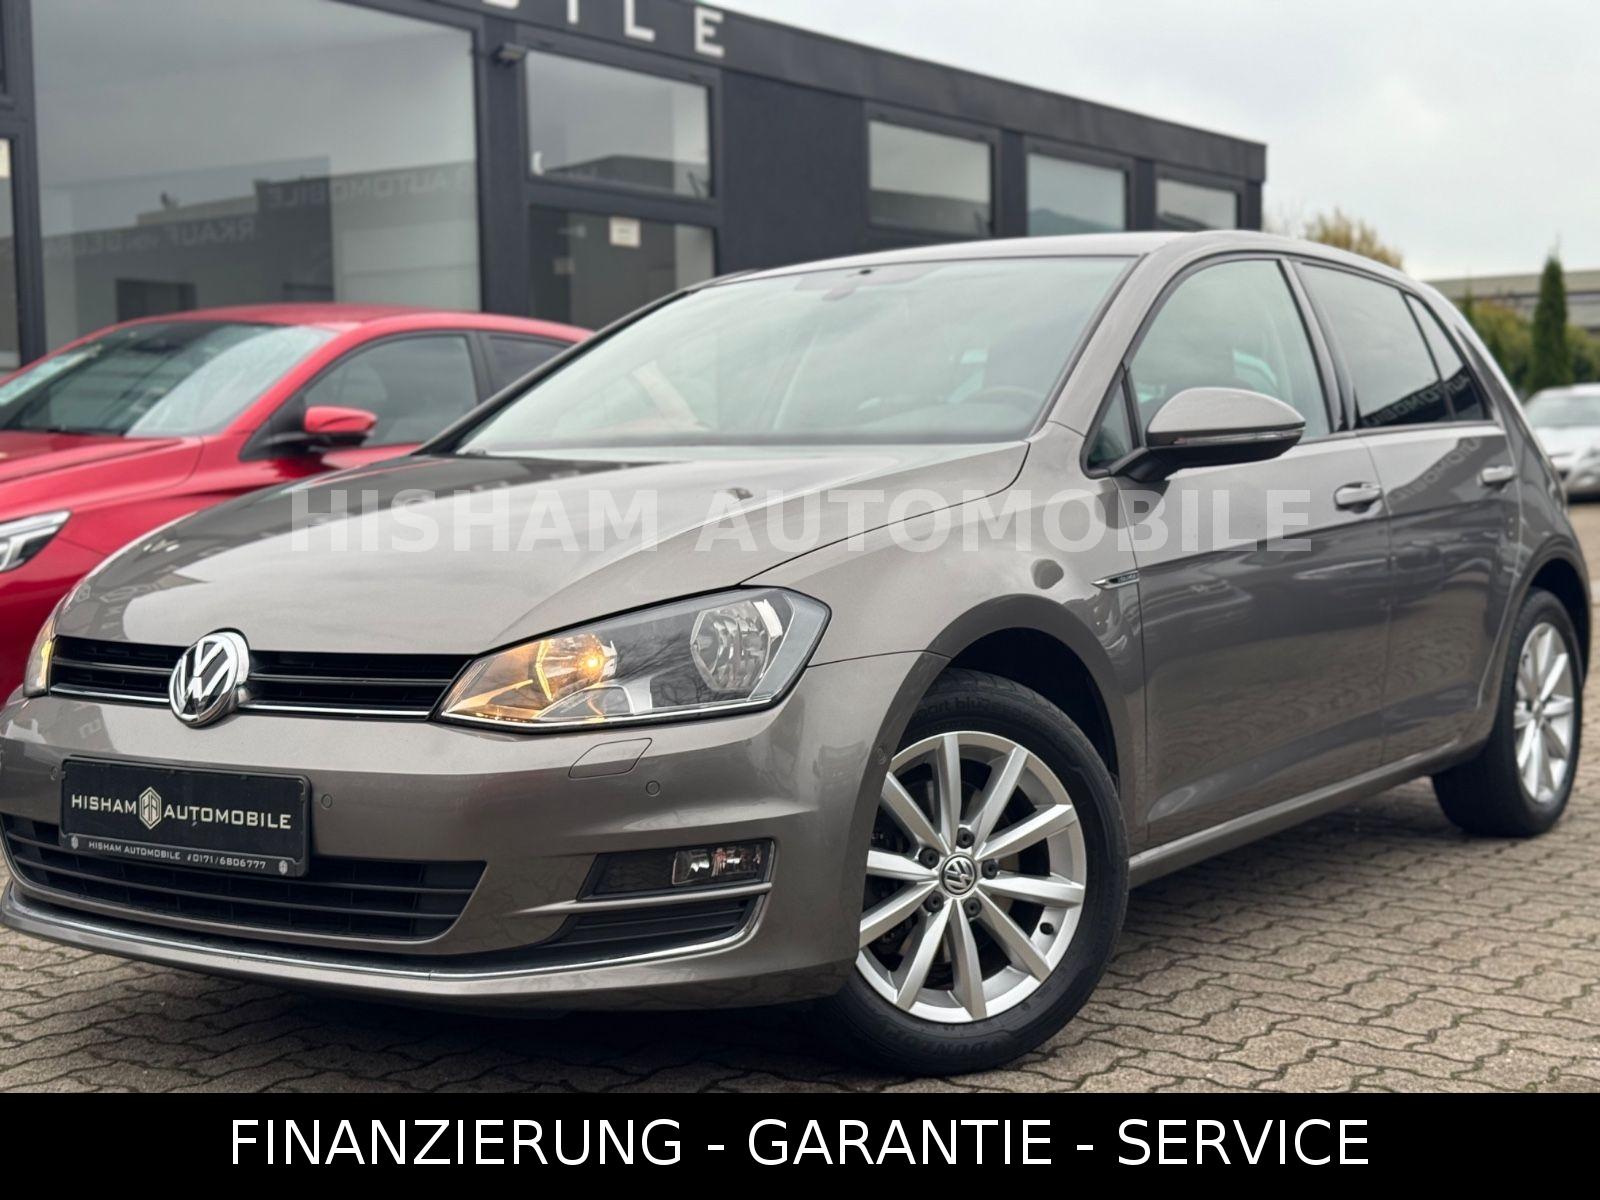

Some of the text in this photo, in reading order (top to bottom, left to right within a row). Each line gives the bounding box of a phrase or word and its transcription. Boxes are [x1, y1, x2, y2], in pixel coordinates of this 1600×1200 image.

[482, 0, 725, 57] ILE
[71, 794, 292, 830] HISHAM AUTOMOBILE
[88, 840, 122, 852] HISHAM
[124, 846, 181, 860] AUTOMOBILE
